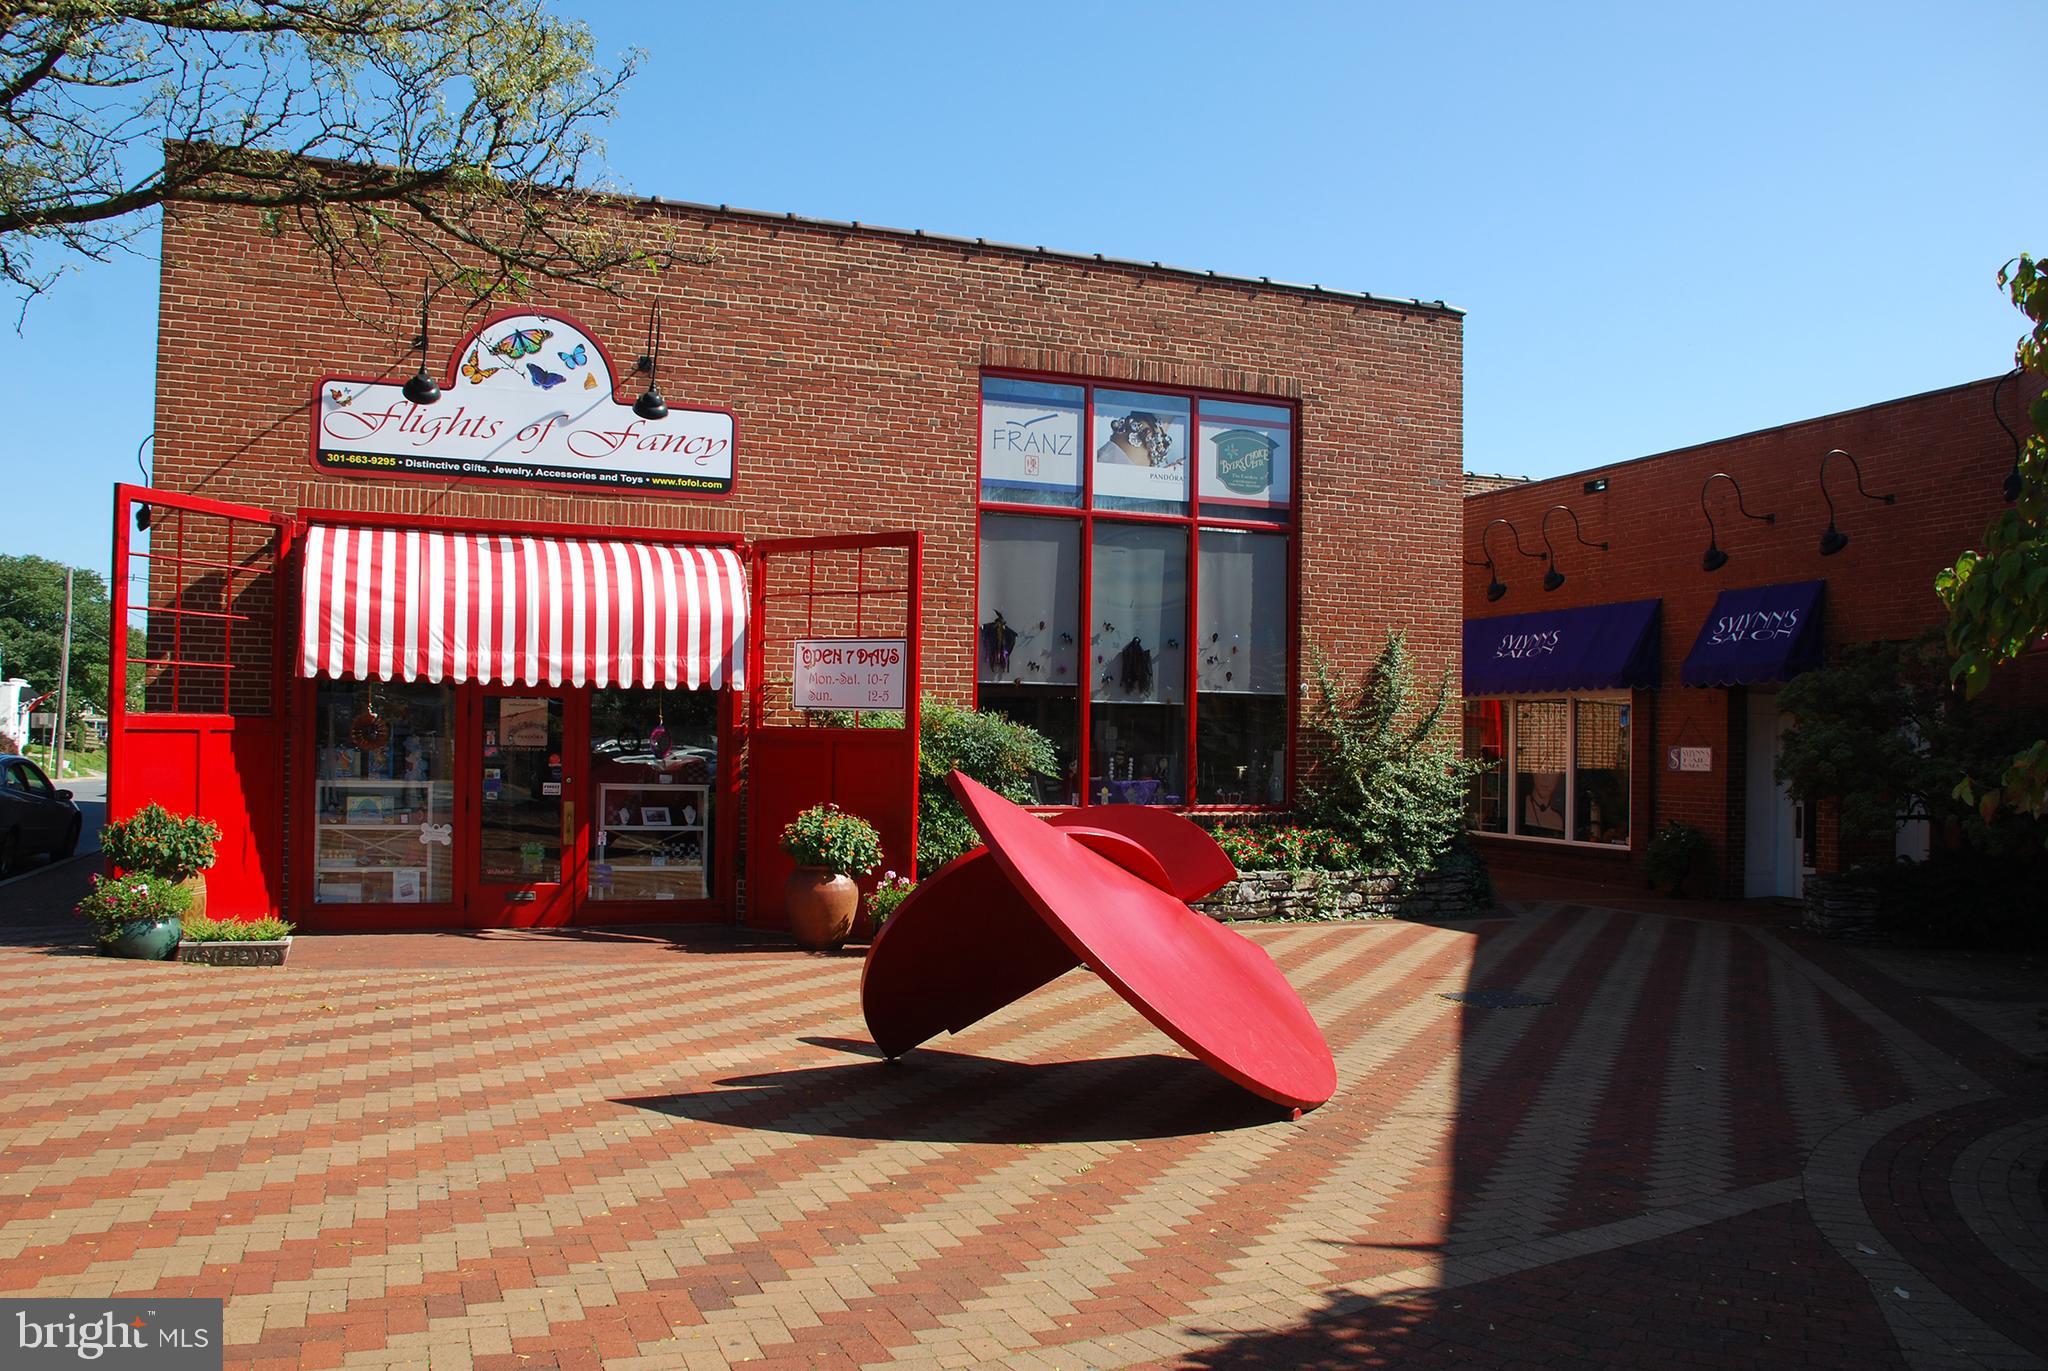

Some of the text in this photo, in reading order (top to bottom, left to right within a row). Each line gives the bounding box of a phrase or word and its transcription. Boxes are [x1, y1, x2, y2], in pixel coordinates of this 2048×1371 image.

[323, 400, 728, 466] Flights of Fancy
[993, 429, 1073, 456] FRANZ
[326, 453, 723, 490] 301-663-9295 Distinctive Gifts, Jewelry, Accessories and Toys www.fofol.com
[1712, 608, 1800, 635] SYLYNN'S
[1706, 628, 1793, 646] SALON
[802, 647, 900, 667] OPEN 7 DAYS
[1492, 645, 1555, 659] SALON
[867, 673, 890, 685] 10-7
[808, 689, 890, 702] Sun. 12-5
